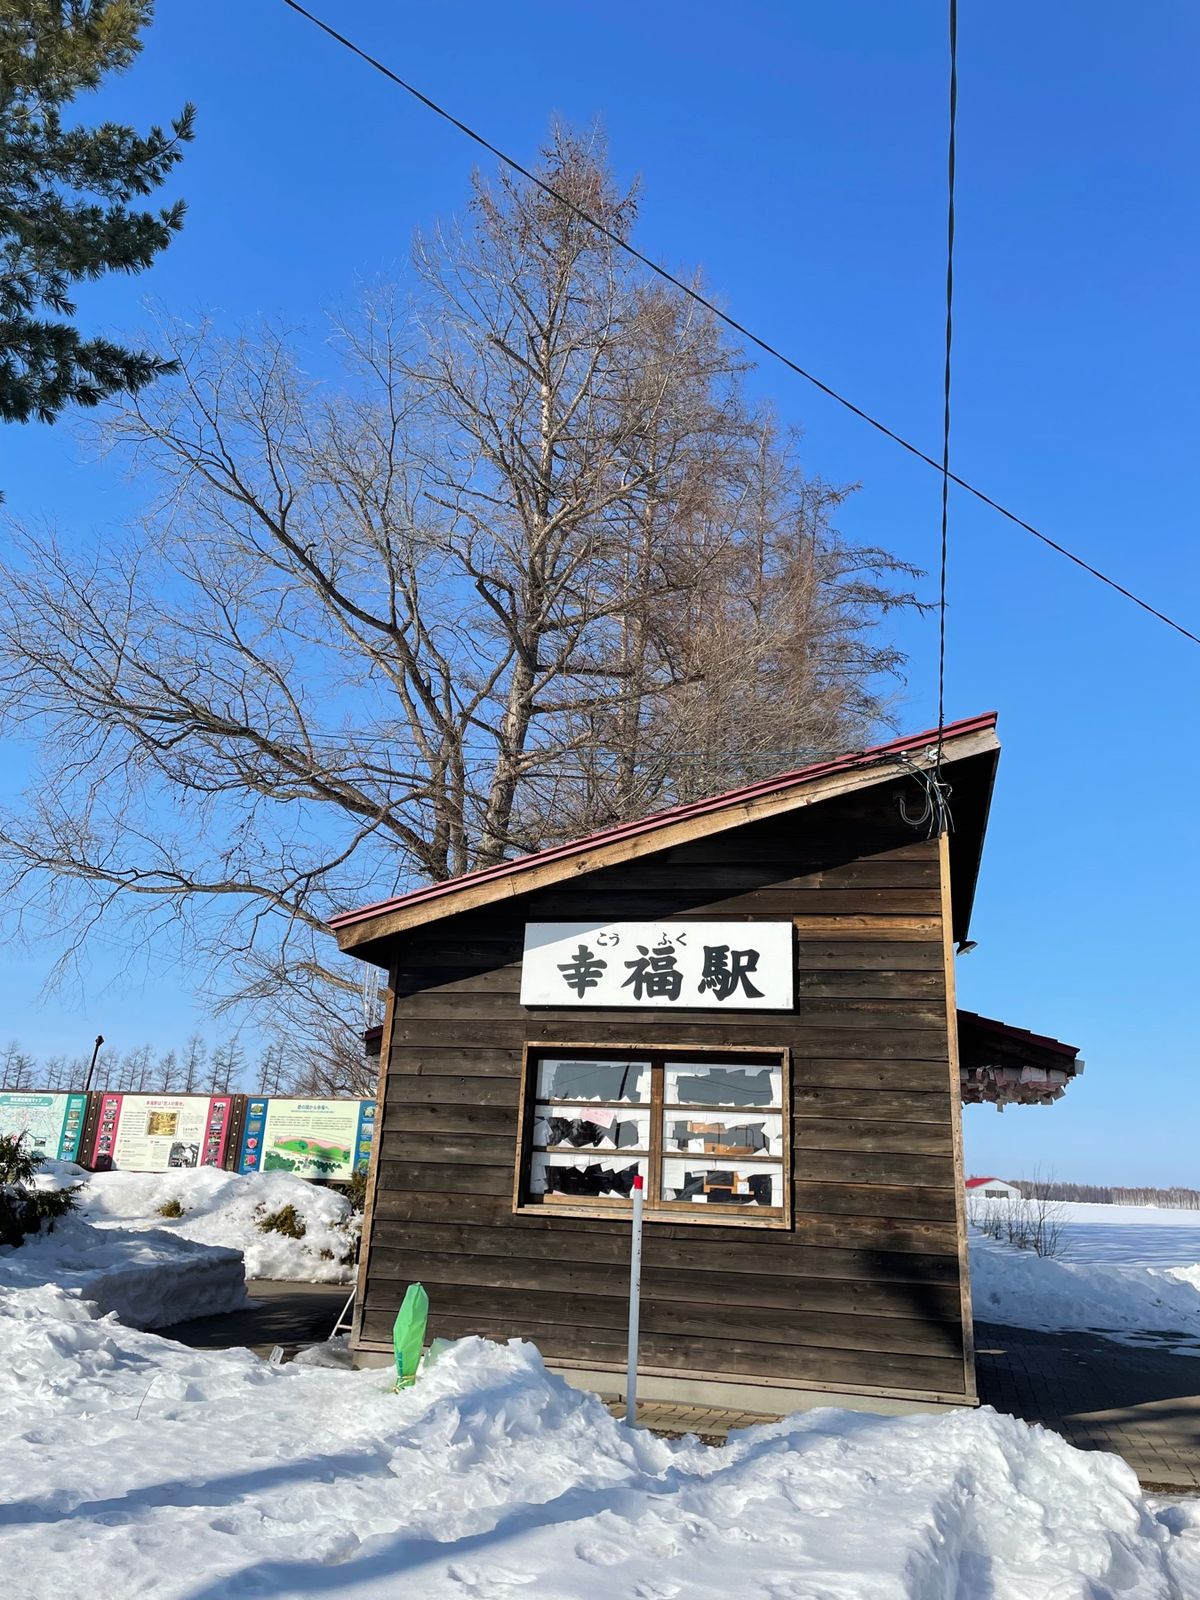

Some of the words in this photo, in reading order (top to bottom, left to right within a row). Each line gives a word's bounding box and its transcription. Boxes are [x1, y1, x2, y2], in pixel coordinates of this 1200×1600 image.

[596, 932, 620, 946] こう
[657, 932, 687, 946] ふく
[556, 944, 766, 1001] 幸福駅
